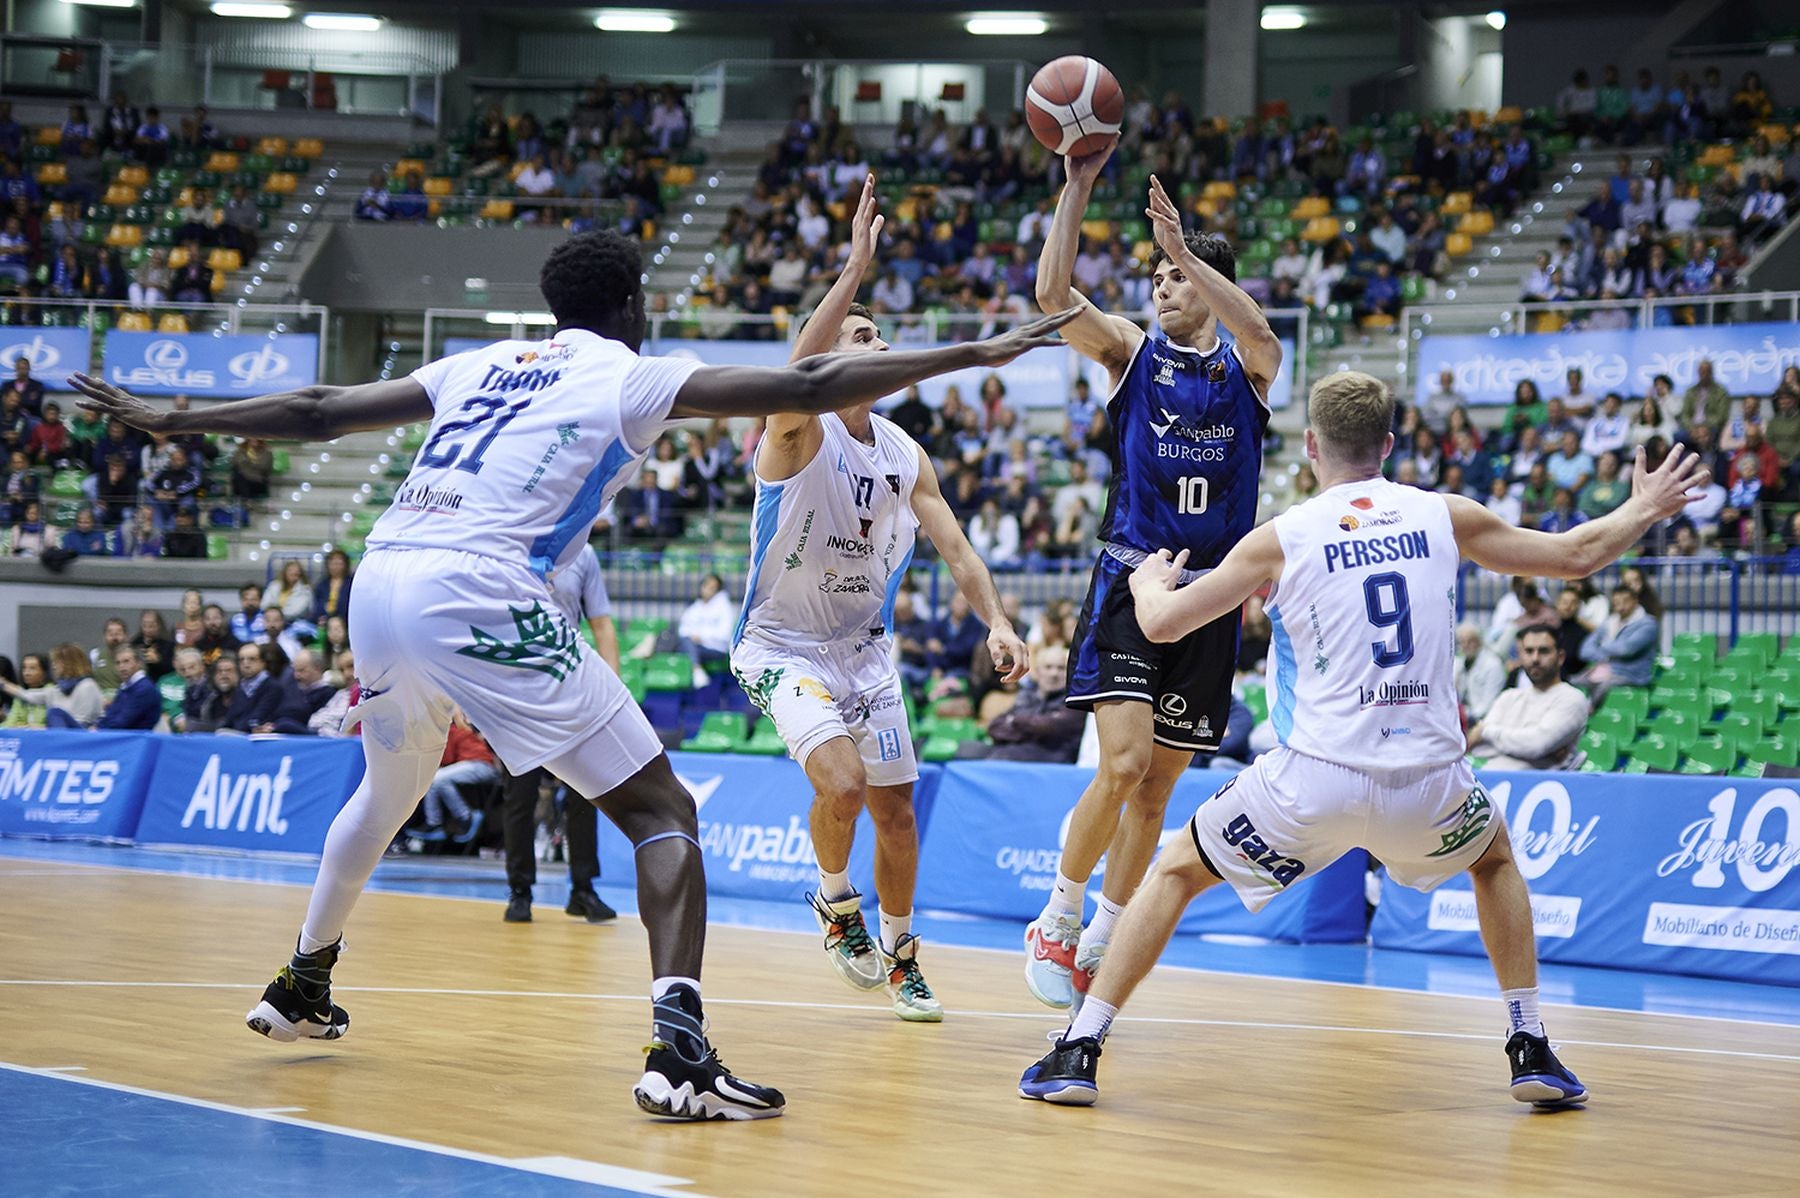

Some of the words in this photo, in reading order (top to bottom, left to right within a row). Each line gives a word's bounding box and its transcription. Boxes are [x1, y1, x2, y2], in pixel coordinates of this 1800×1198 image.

[112, 366, 216, 388] LEXUS
[417, 396, 532, 475] 21
[1157, 442, 1225, 462] BURGOS
[522, 465, 546, 493] RURAL
[399, 482, 415, 504] La
[416, 484, 463, 512] Opinión
[1177, 476, 1209, 515] 10
[1323, 530, 1430, 573] PERSSON
[1362, 571, 1415, 669] 9
[1114, 675, 1148, 685] GIVOVA
[1359, 685, 1375, 705] La
[1379, 680, 1429, 706] Opinión
[1153, 713, 1193, 729] EXUS
[1222, 813, 1305, 888] gaza
[1692, 787, 1800, 892] 10
[1654, 916, 1728, 936] Mobiliario
[1732, 921, 1751, 938] de
